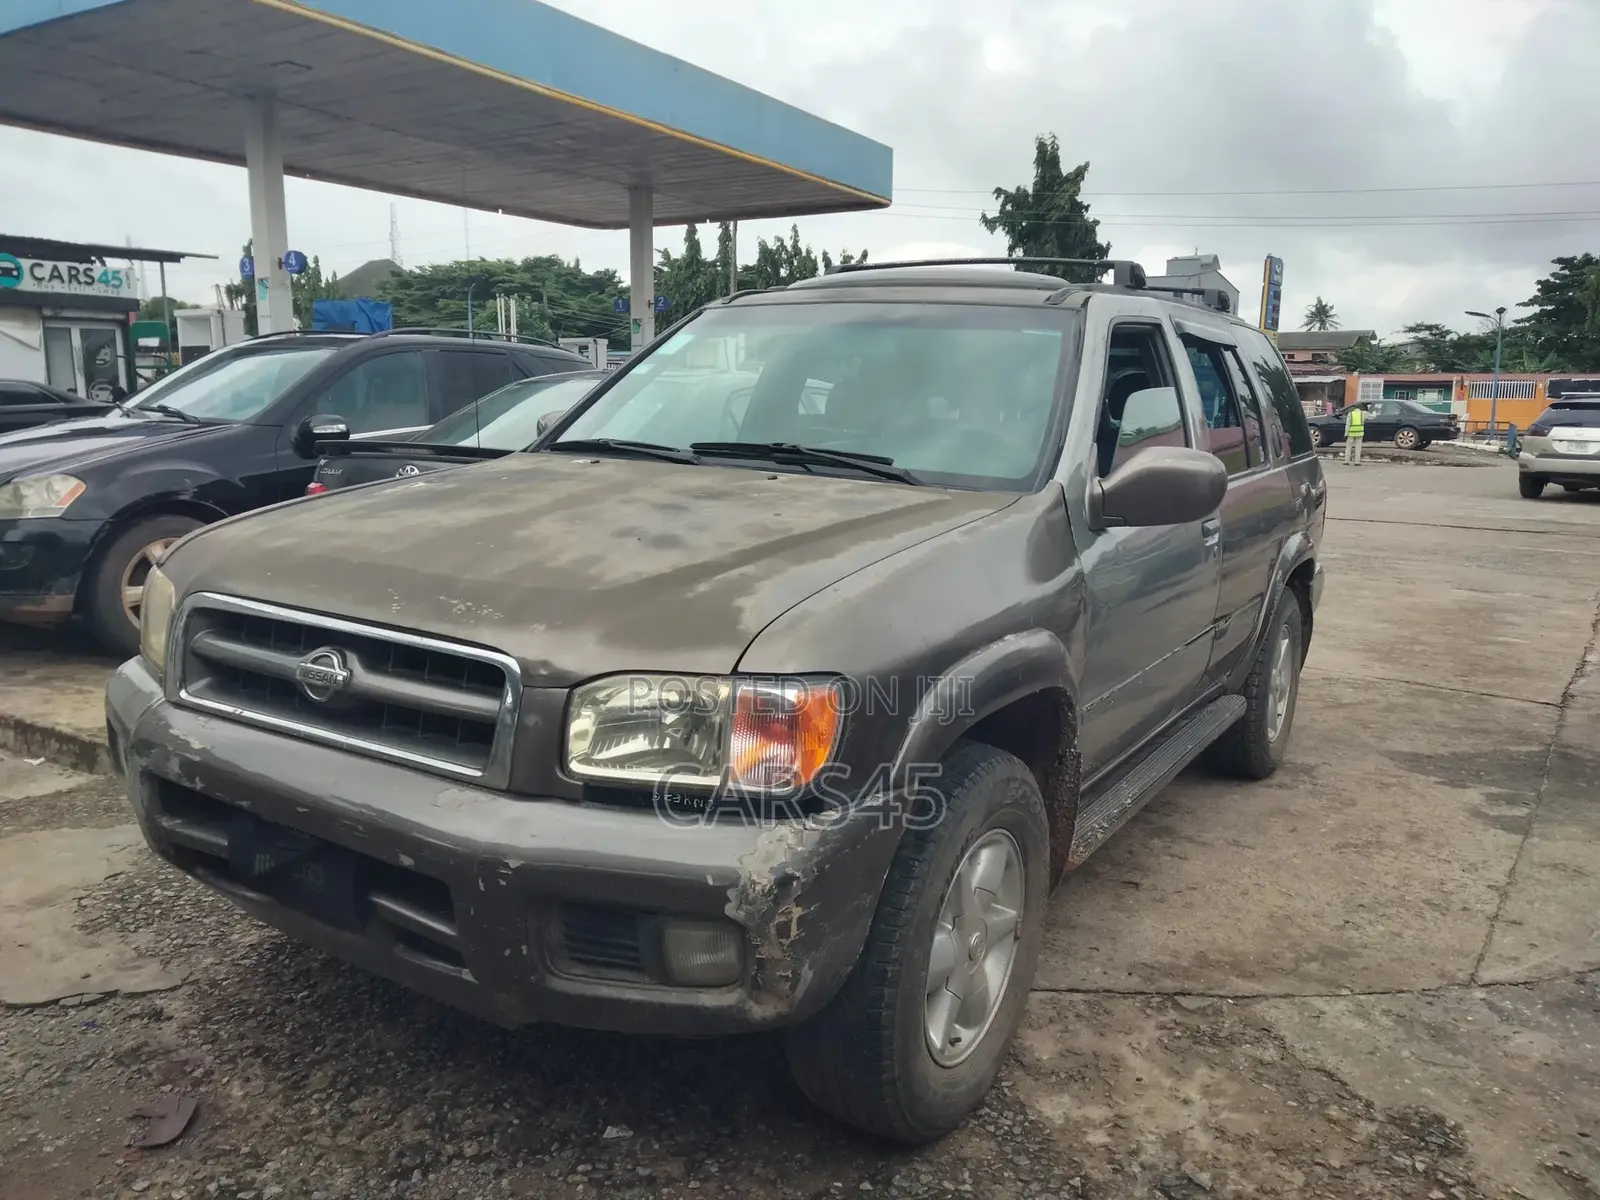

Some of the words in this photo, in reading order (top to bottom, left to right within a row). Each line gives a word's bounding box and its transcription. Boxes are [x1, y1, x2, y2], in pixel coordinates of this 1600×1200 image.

[243, 258, 250, 272] 3
[288, 251, 297, 266] 4
[29, 262, 124, 289] CARS45
[617, 299, 622, 308] 1
[658, 296, 664, 306] 2
[300, 667, 339, 685] NISSAN
